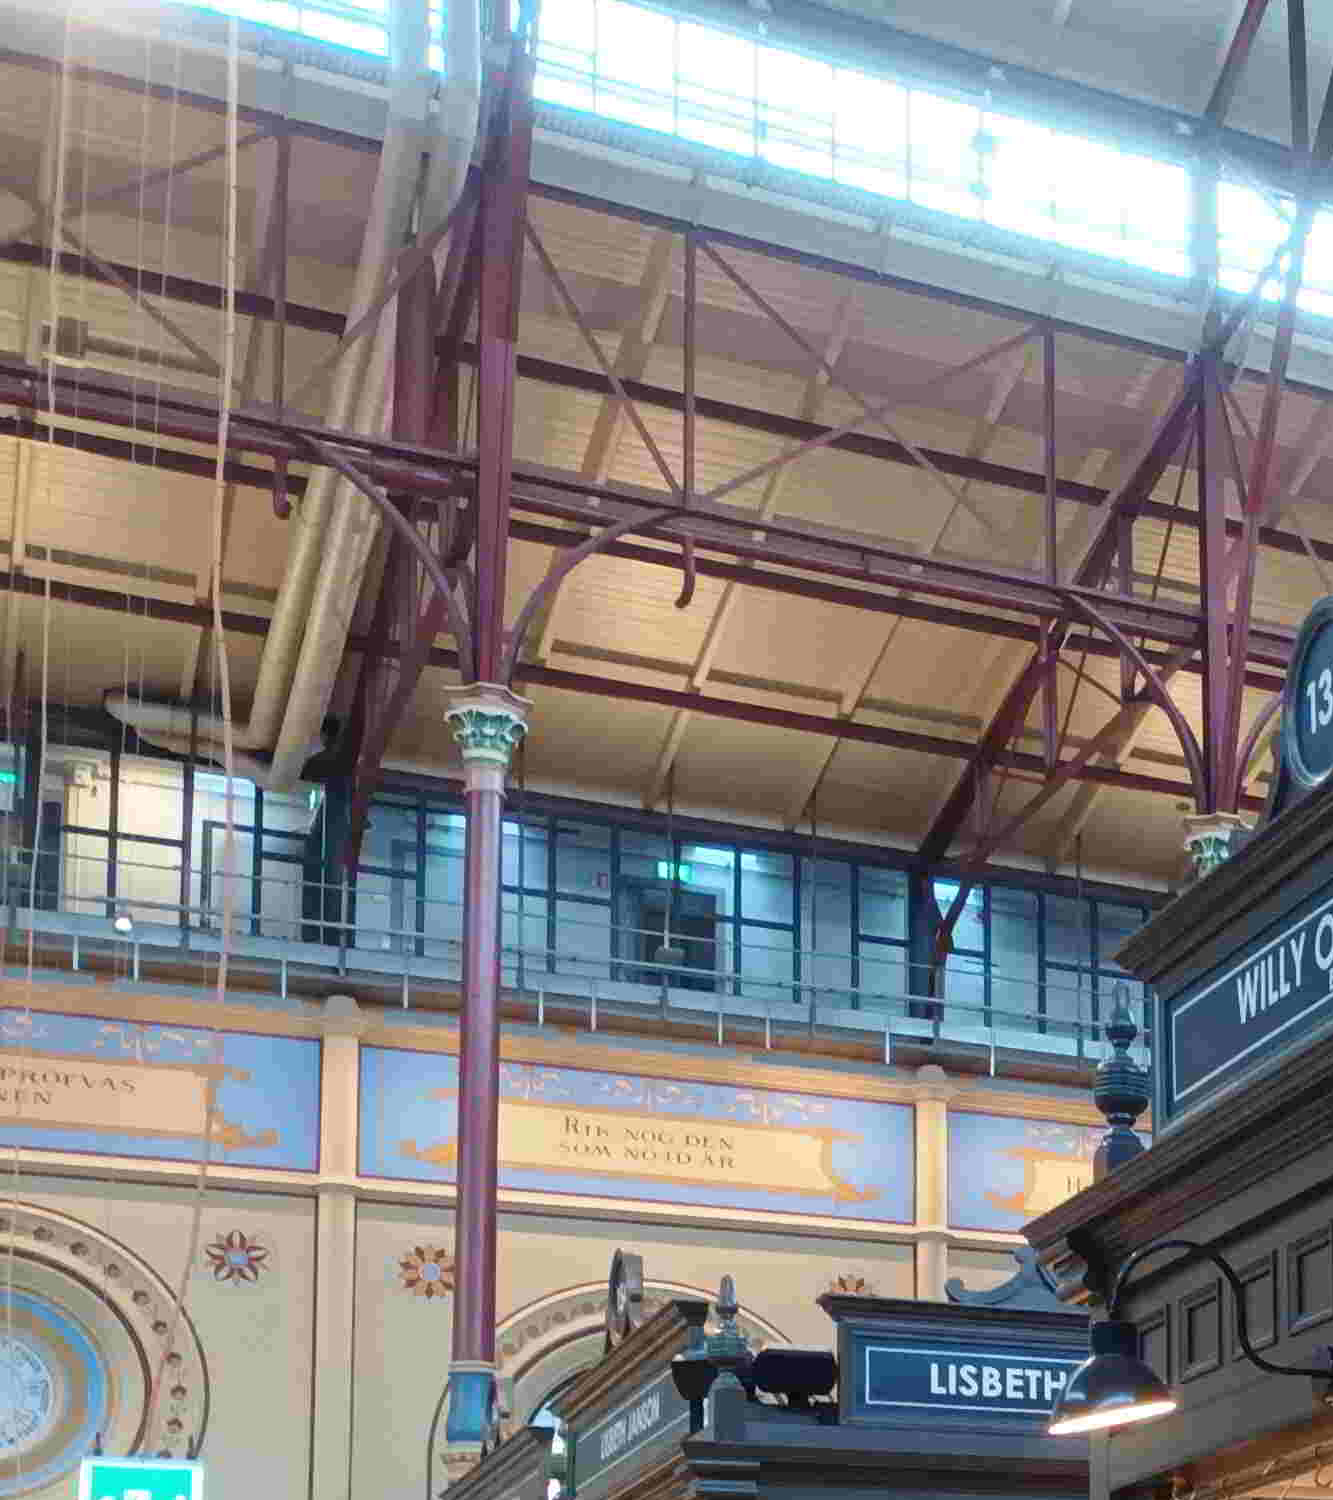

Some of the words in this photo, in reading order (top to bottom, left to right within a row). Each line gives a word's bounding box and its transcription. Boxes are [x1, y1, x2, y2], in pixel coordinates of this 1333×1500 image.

[1236, 931, 1305, 1025] WILLY
[684, 1134, 735, 1151] DEN
[930, 1362, 1068, 1401] LISBETH
